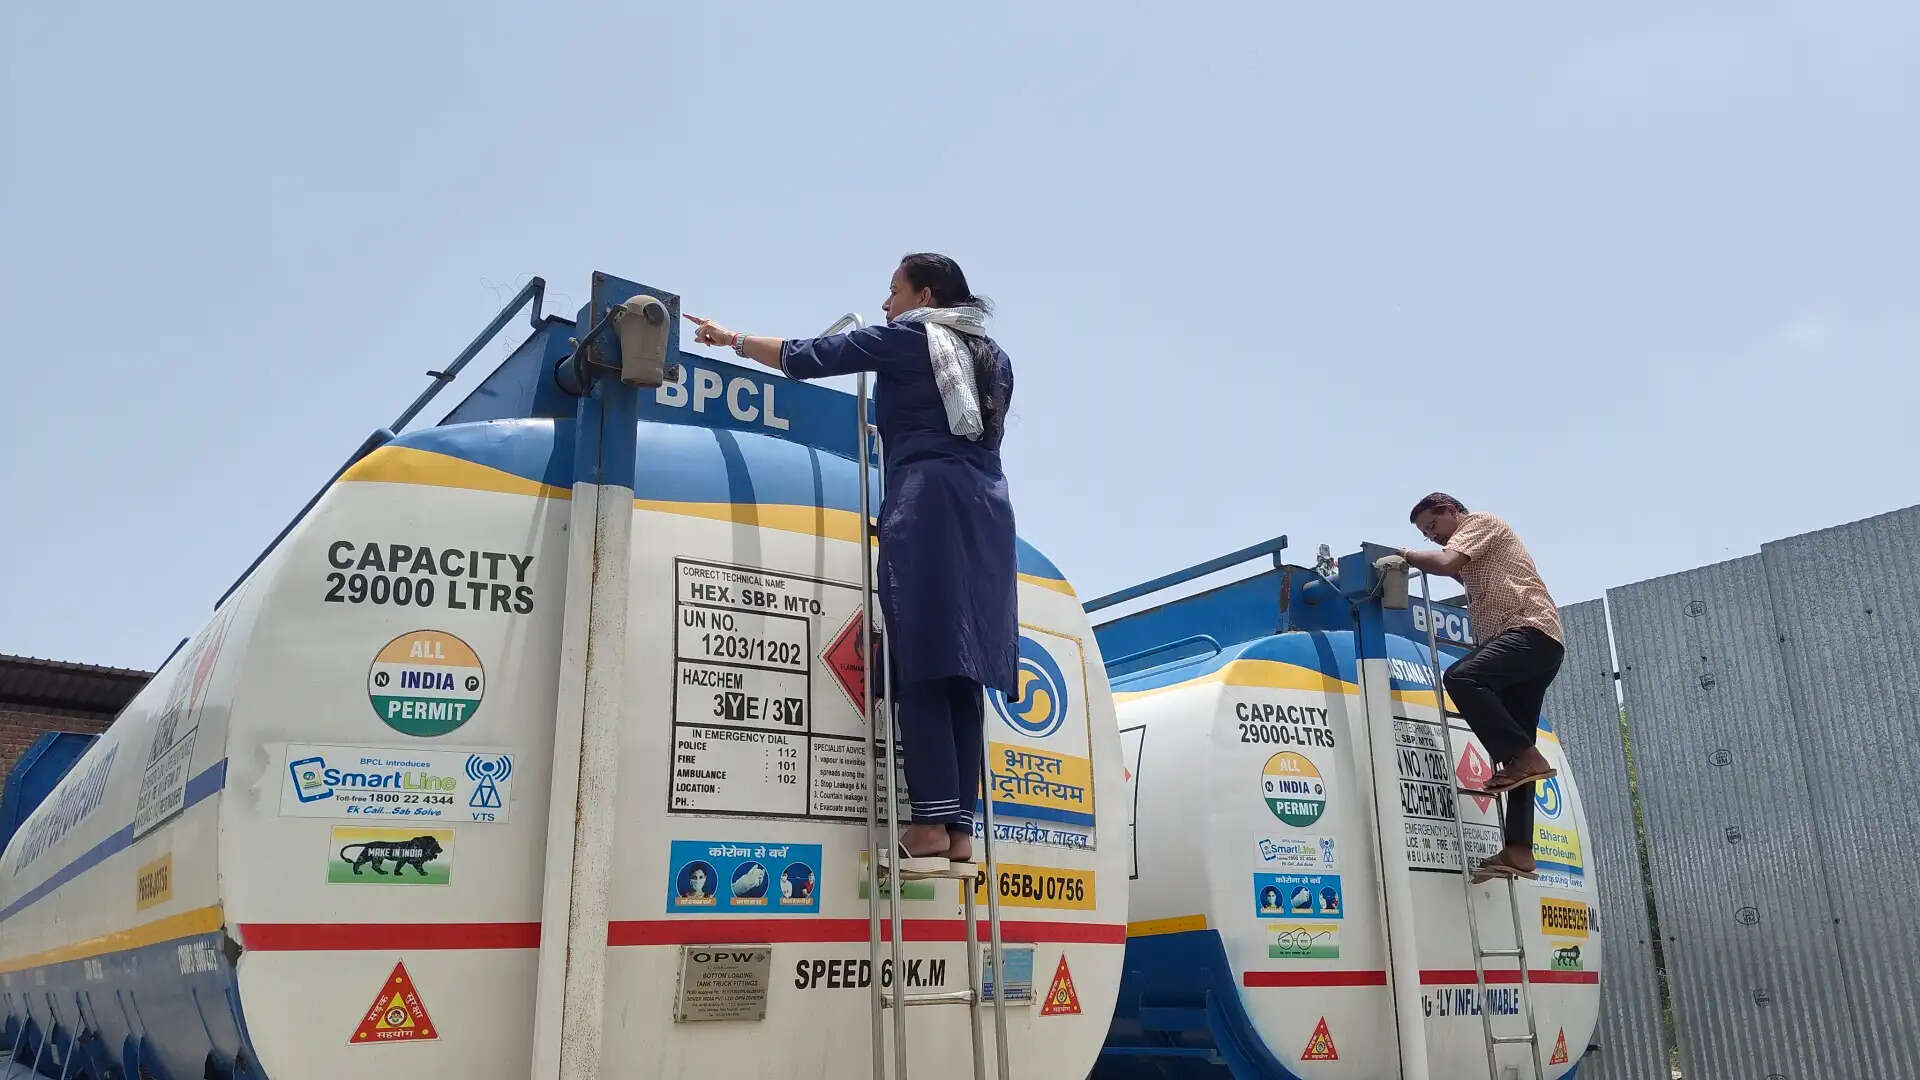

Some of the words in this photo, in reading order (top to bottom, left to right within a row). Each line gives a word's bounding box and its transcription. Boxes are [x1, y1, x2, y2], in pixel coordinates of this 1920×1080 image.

[656, 363, 790, 431] BPCL
[328, 540, 535, 582] CAPACITY
[682, 566, 720, 580] CORRECT
[721, 571, 764, 586] TECHNICAL
[765, 580, 786, 590] NAME
[324, 572, 435, 607] 29000
[448, 580, 534, 614] LTRS
[691, 582, 736, 604] HEX.
[741, 589, 778, 609] SBP.
[784, 595, 826, 616] MTO.
[683, 609, 706, 629] UN
[711, 613, 738, 632] NO.
[1412, 605, 1474, 645] BPCL
[408, 639, 446, 660] ALL
[702, 633, 801, 665] 1203/1202
[400, 670, 455, 691] INDIA
[682, 668, 744, 690] HAZCHEM
[387, 700, 467, 721] PERMIT
[1235, 702, 1328, 727] CAPACITY
[692, 728, 702, 739] IN
[704, 729, 766, 744] EMERGENCY
[767, 735, 789, 746] DIAL
[1238, 723, 1335, 748] 29000-LTRS
[678, 740, 707, 751] POLICE
[777, 748, 797, 758] 112
[813, 743, 845, 754] SPECIALIST
[846, 746, 866, 756] ADVICE
[360, 757, 383, 766] BPCL
[385, 758, 431, 768] introduces
[677, 754, 696, 764] FIRE
[777, 761, 796, 771] 101
[1004, 749, 1063, 775] भारत
[1280, 757, 1301, 773] ALL
[322, 767, 457, 791] SmartLine
[676, 769, 727, 780] AMBULANCE
[777, 774, 797, 784] 102
[1279, 780, 1311, 794] INDIA
[368, 793, 400, 804] 1800
[403, 794, 420, 804] 22
[422, 795, 454, 805] 4344
[676, 783, 716, 794] LOCATION
[1276, 800, 1319, 816] PERMIT
[1400, 783, 1439, 817] AZCHEM
[472, 812, 495, 822] VTS
[1539, 828, 1569, 845] Bharat
[367, 847, 391, 857] MAKE
[391, 848, 400, 857] IN
[401, 848, 423, 858] INDIA
[709, 844, 751, 858] कोरोना
[754, 846, 766, 859] से
[1533, 843, 1577, 861] Petroleum
[693, 952, 754, 963] OPW
[794, 959, 873, 990] SPEED
[880, 958, 946, 988] 6K.M
